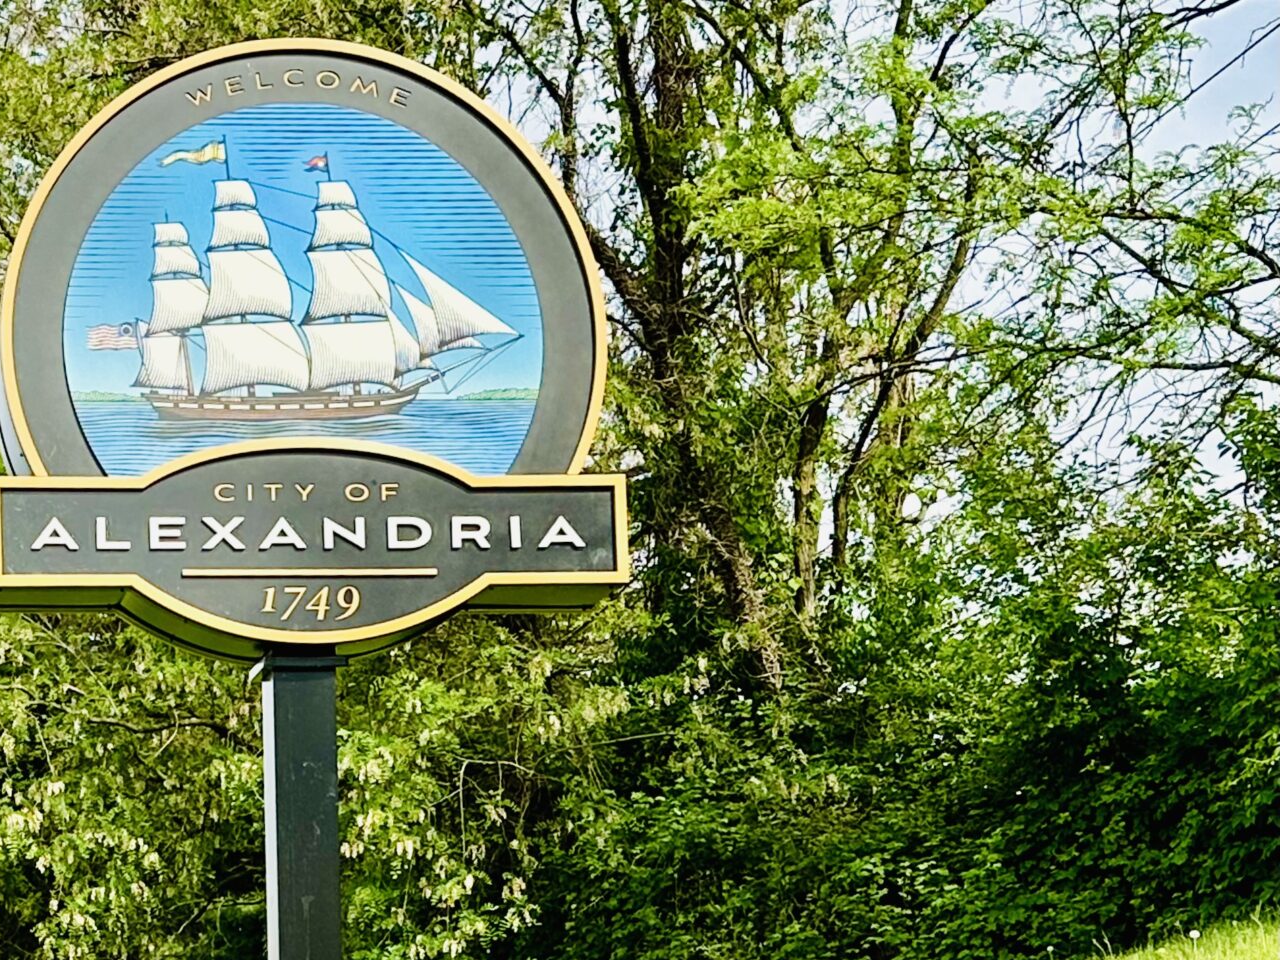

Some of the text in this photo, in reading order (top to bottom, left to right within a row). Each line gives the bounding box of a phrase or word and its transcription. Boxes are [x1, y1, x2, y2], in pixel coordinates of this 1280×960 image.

[185, 68, 413, 108] WELCOME
[213, 482, 400, 502] CITY OF
[30, 515, 587, 551] ALEXANDRIA
[260, 585, 361, 621] 1749
